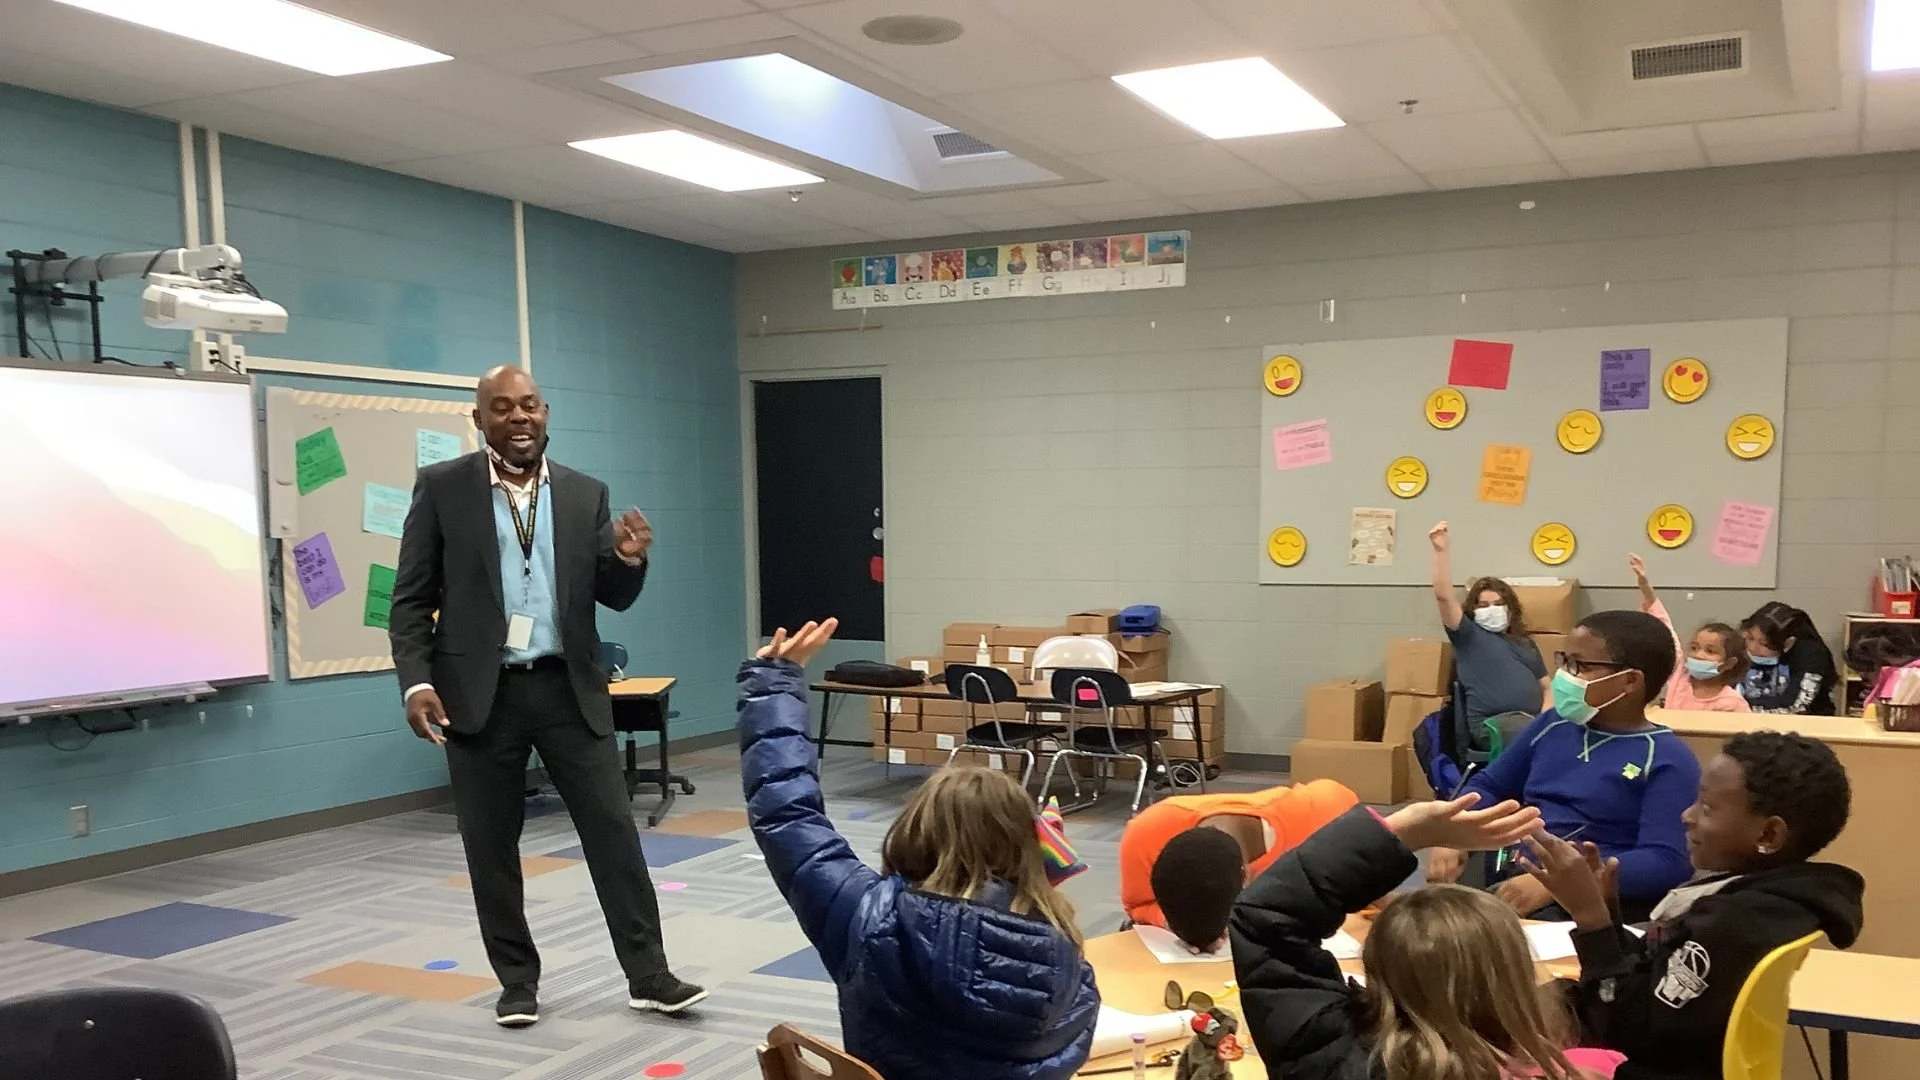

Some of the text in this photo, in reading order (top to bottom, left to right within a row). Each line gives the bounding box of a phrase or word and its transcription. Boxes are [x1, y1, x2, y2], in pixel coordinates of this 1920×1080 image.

[840, 291, 857, 305] Aa
[873, 289, 889, 303] Bb
[904, 286, 922, 300] Cc
[939, 284, 957, 298] Dd
[972, 281, 990, 296] Ee
[1008, 278, 1024, 292] Ff
[1042, 275, 1063, 292] Gg
